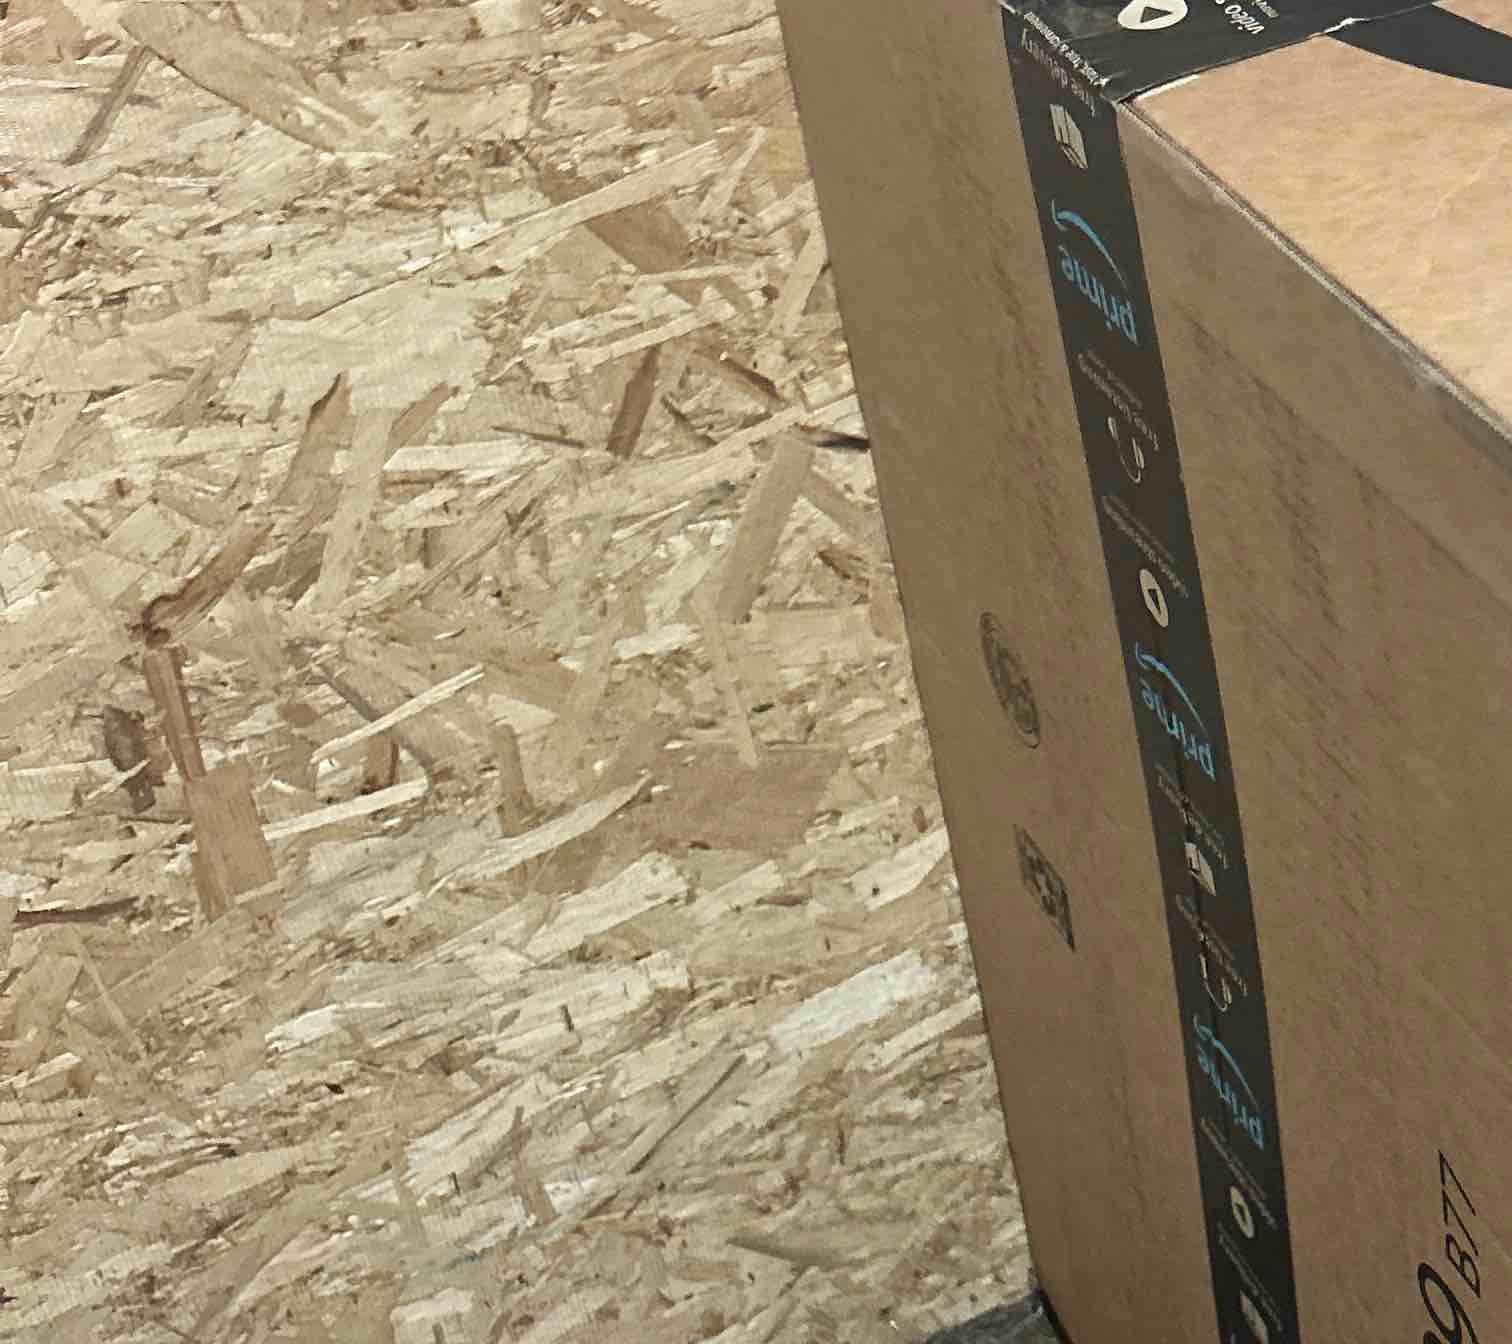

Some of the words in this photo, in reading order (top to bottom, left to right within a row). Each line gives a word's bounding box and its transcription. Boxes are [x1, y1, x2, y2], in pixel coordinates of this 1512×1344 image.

[1224, 3, 1265, 35] video
[1058, 243, 1140, 347] prime
[1139, 676, 1218, 784] prime
